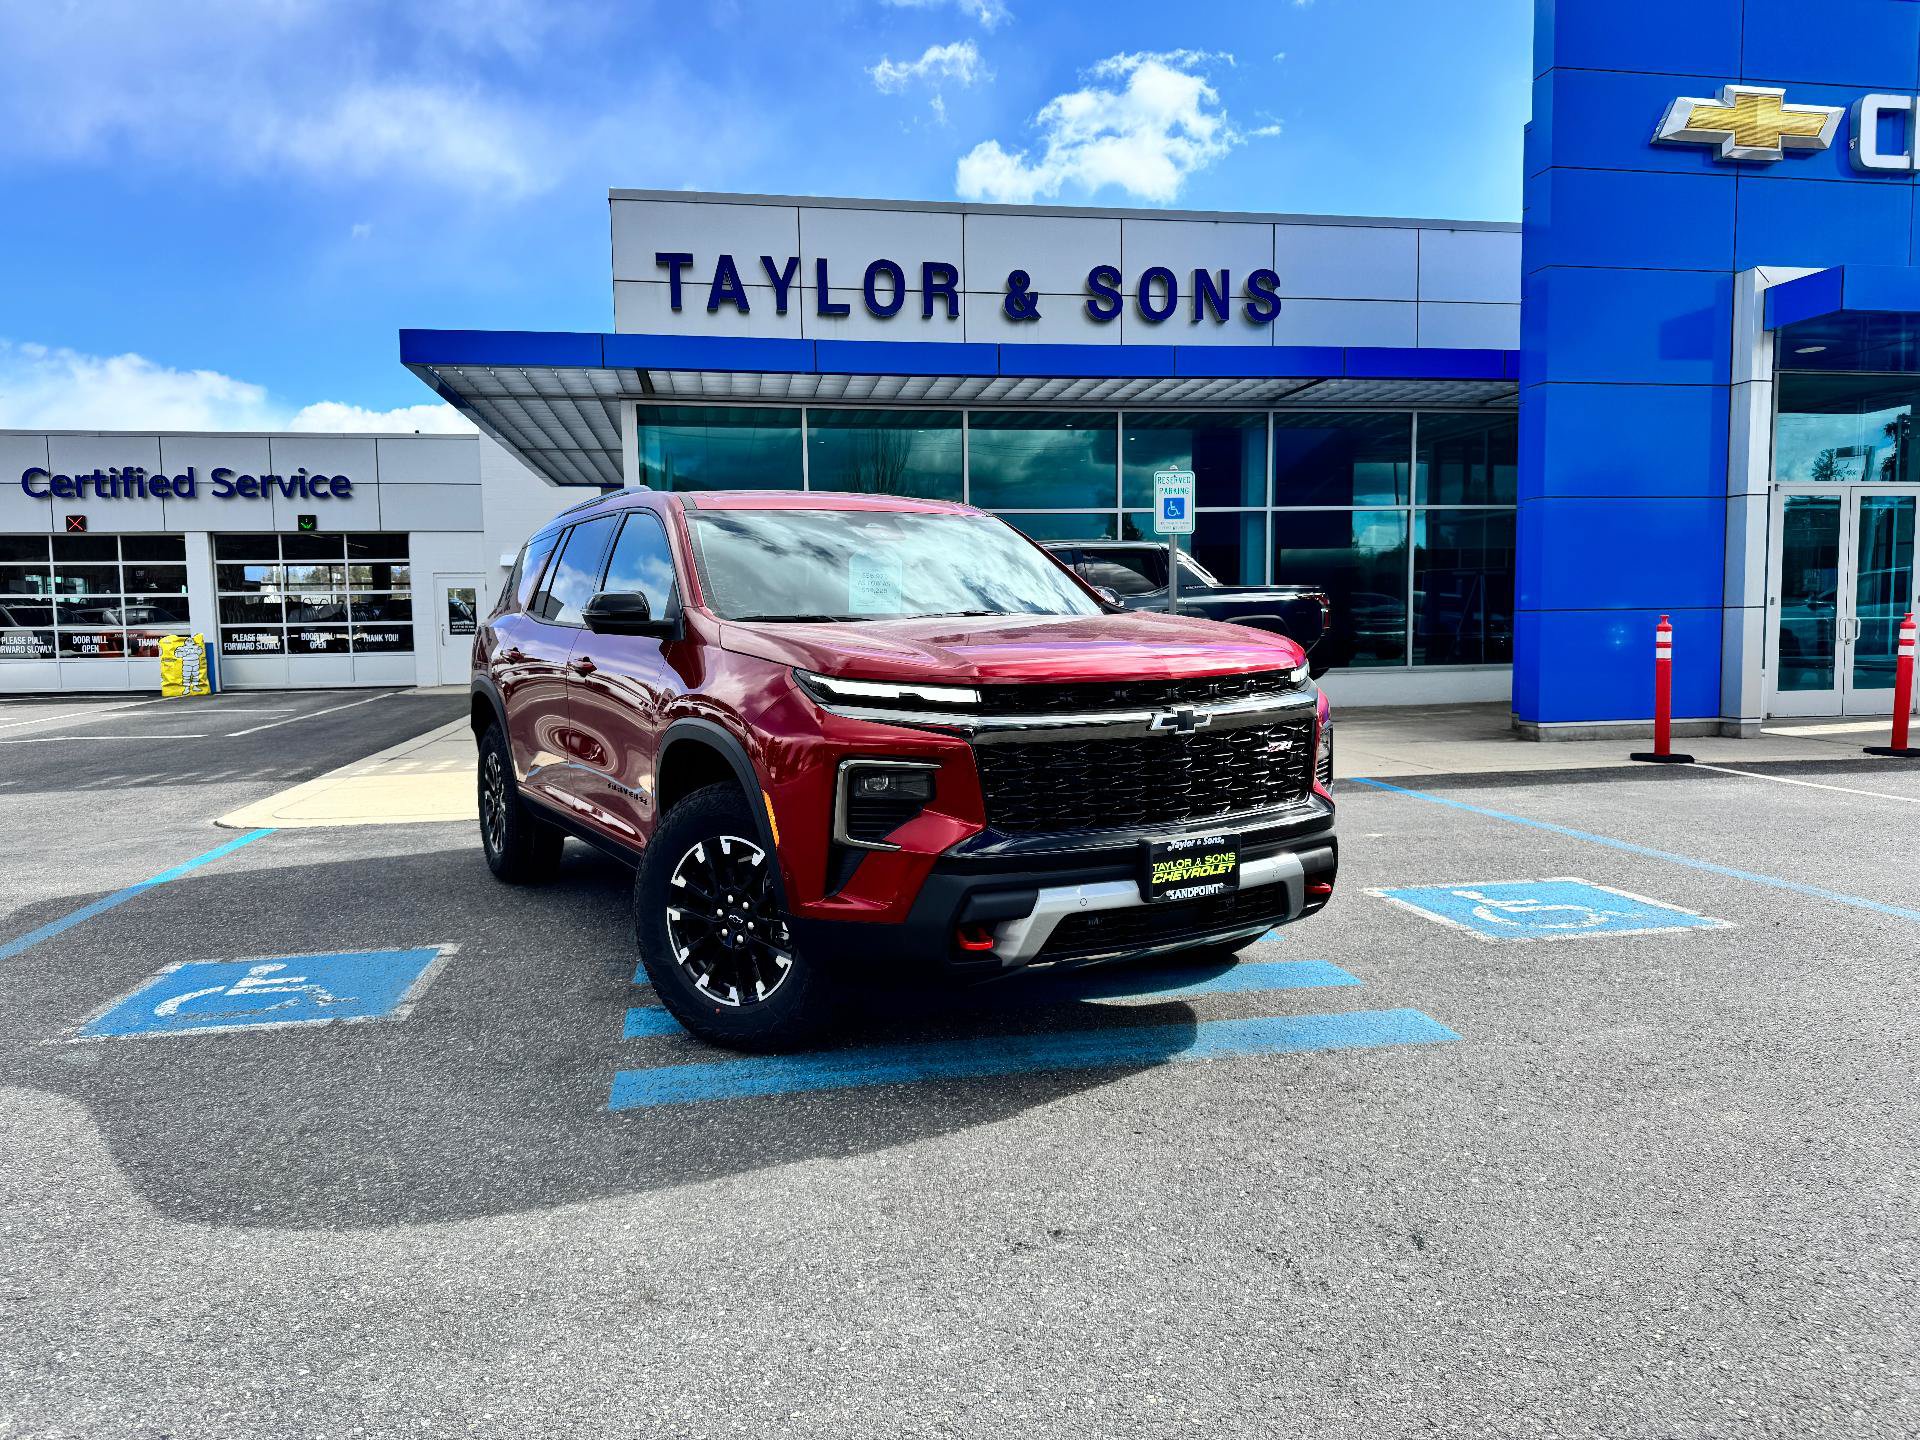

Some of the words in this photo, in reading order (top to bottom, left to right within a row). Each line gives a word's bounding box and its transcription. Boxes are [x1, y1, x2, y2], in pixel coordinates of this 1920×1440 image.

[655, 252, 960, 319] TAYLOR
[1003, 269, 1042, 321] &
[1084, 265, 1283, 323] SONS
[21, 466, 198, 500] Certified
[210, 466, 354, 500] Service
[1157, 476, 1191, 485] RESERVED
[1159, 487, 1190, 495] PARKING
[1, 636, 27, 645] PLEASE
[27, 635, 44, 645] PULL
[73, 636, 91, 644] DOOR
[92, 635, 108, 644] WILL
[232, 633, 256, 642] PLEASE
[363, 634, 383, 642] THANK
[384, 633, 399, 642] YOU!
[137, 638, 159, 647] THANK
[224, 642, 255, 651] FORWARD
[256, 642, 281, 650] SLOWLY
[309, 640, 327, 649] OPEN
[0, 645, 26, 654] RWARD
[26, 645, 53, 654] SLOWLY
[82, 644, 99, 653] OPEN
[1170, 839, 1195, 851] Taylor
[1152, 858, 1192, 872] TAYLOR
[1194, 857, 1202, 867] &
[1204, 852, 1236, 864] SONS
[1151, 863, 1236, 884] CHEVROLET
[1169, 884, 1220, 900] SANDPOINT
